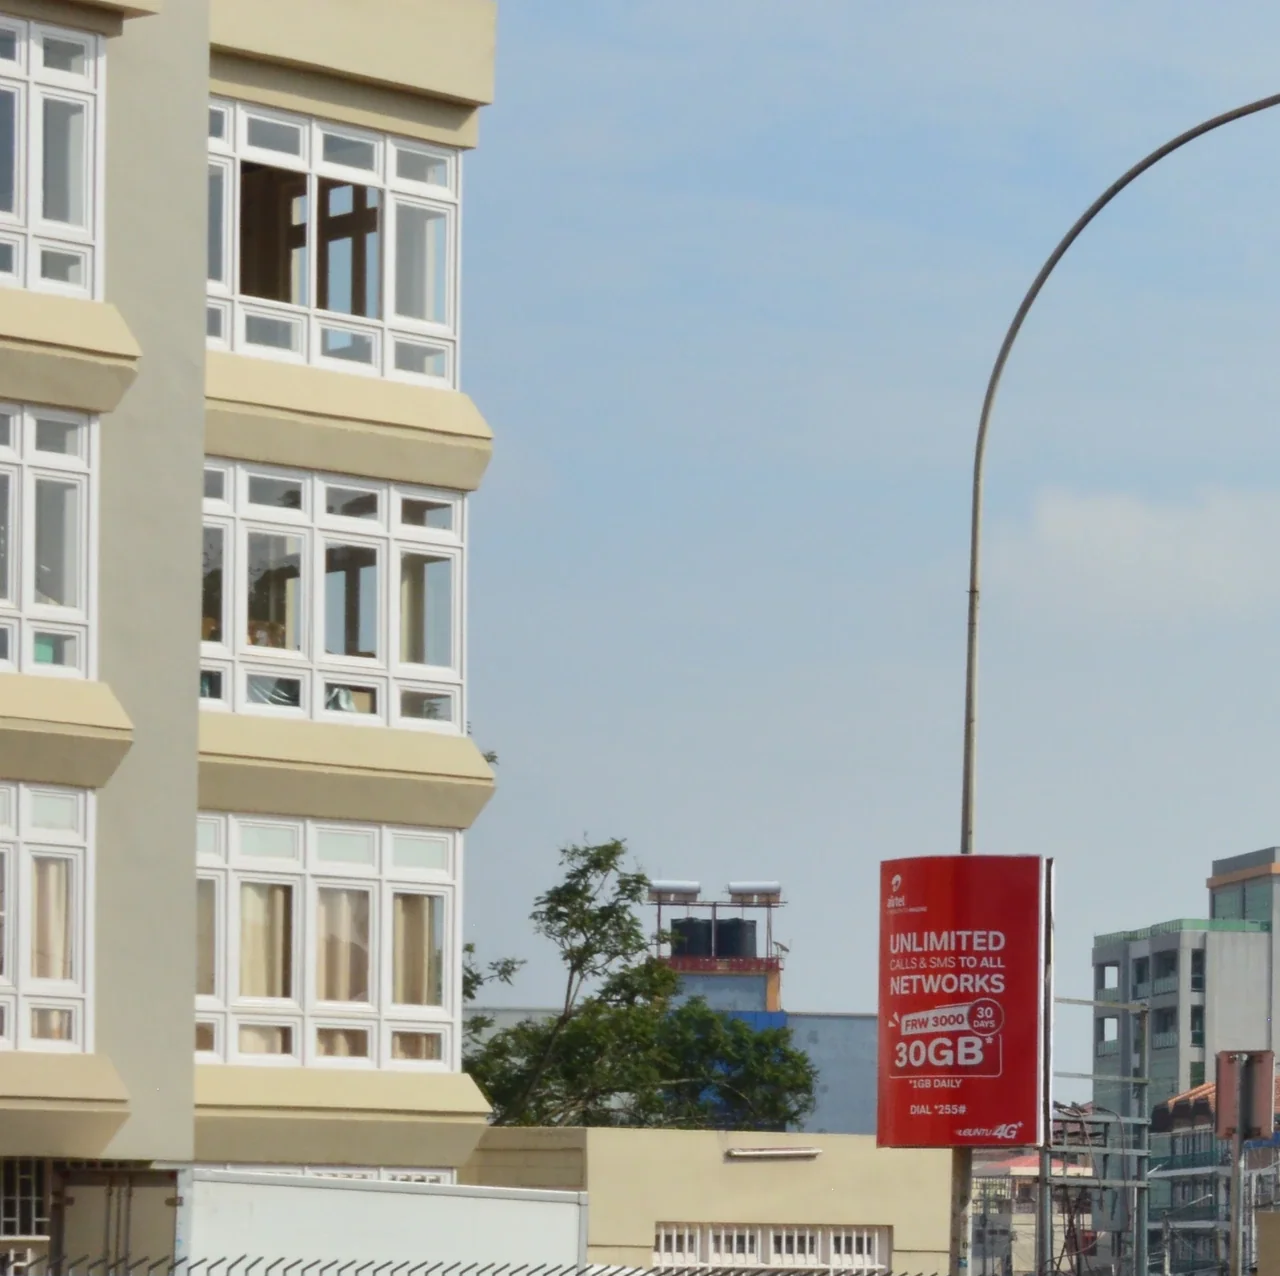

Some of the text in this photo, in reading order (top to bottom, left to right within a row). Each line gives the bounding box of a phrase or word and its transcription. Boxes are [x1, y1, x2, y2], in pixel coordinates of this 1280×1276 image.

[890, 930, 1005, 954] UNLIMITED
[890, 956, 1005, 971] CALLS & SMS TO ALL
[890, 973, 1005, 995] NETWORKS
[976, 1007, 993, 1018] 30
[904, 1013, 965, 1031] FRW 3000
[973, 1020, 996, 1028] DAYS
[933, 1079, 963, 1088] DAILY
[910, 1105, 932, 1115] DIAL
